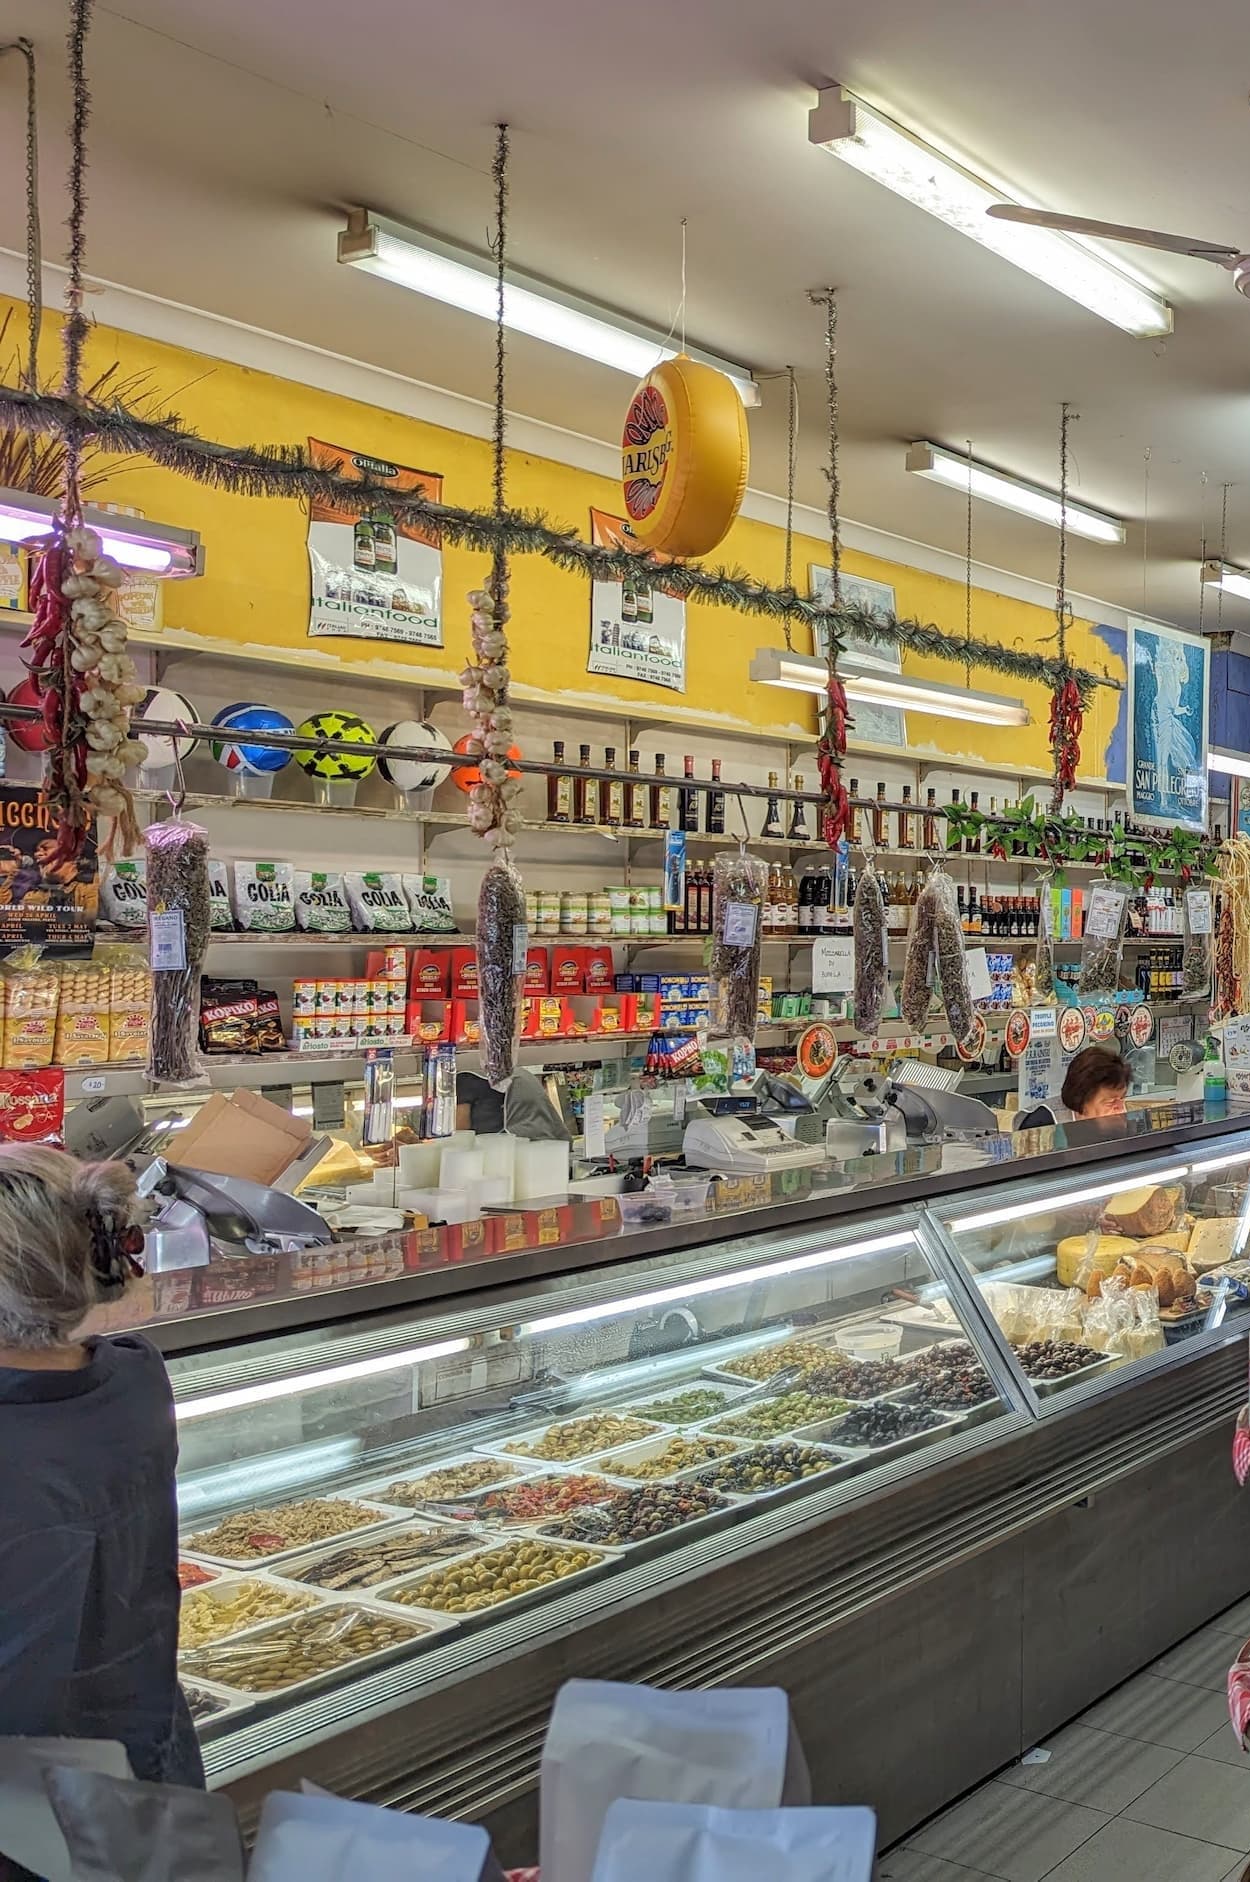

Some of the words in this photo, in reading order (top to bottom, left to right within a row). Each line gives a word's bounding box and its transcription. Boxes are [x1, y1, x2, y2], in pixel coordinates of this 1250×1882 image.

[1136, 769, 1151, 791] SAN
[113, 883, 147, 901] GOL
[247, 883, 290, 902] GOLIA
[299, 890, 344, 907] GOLIA
[361, 890, 404, 907] GOLIA
[204, 1002, 256, 1021] KOPIKO
